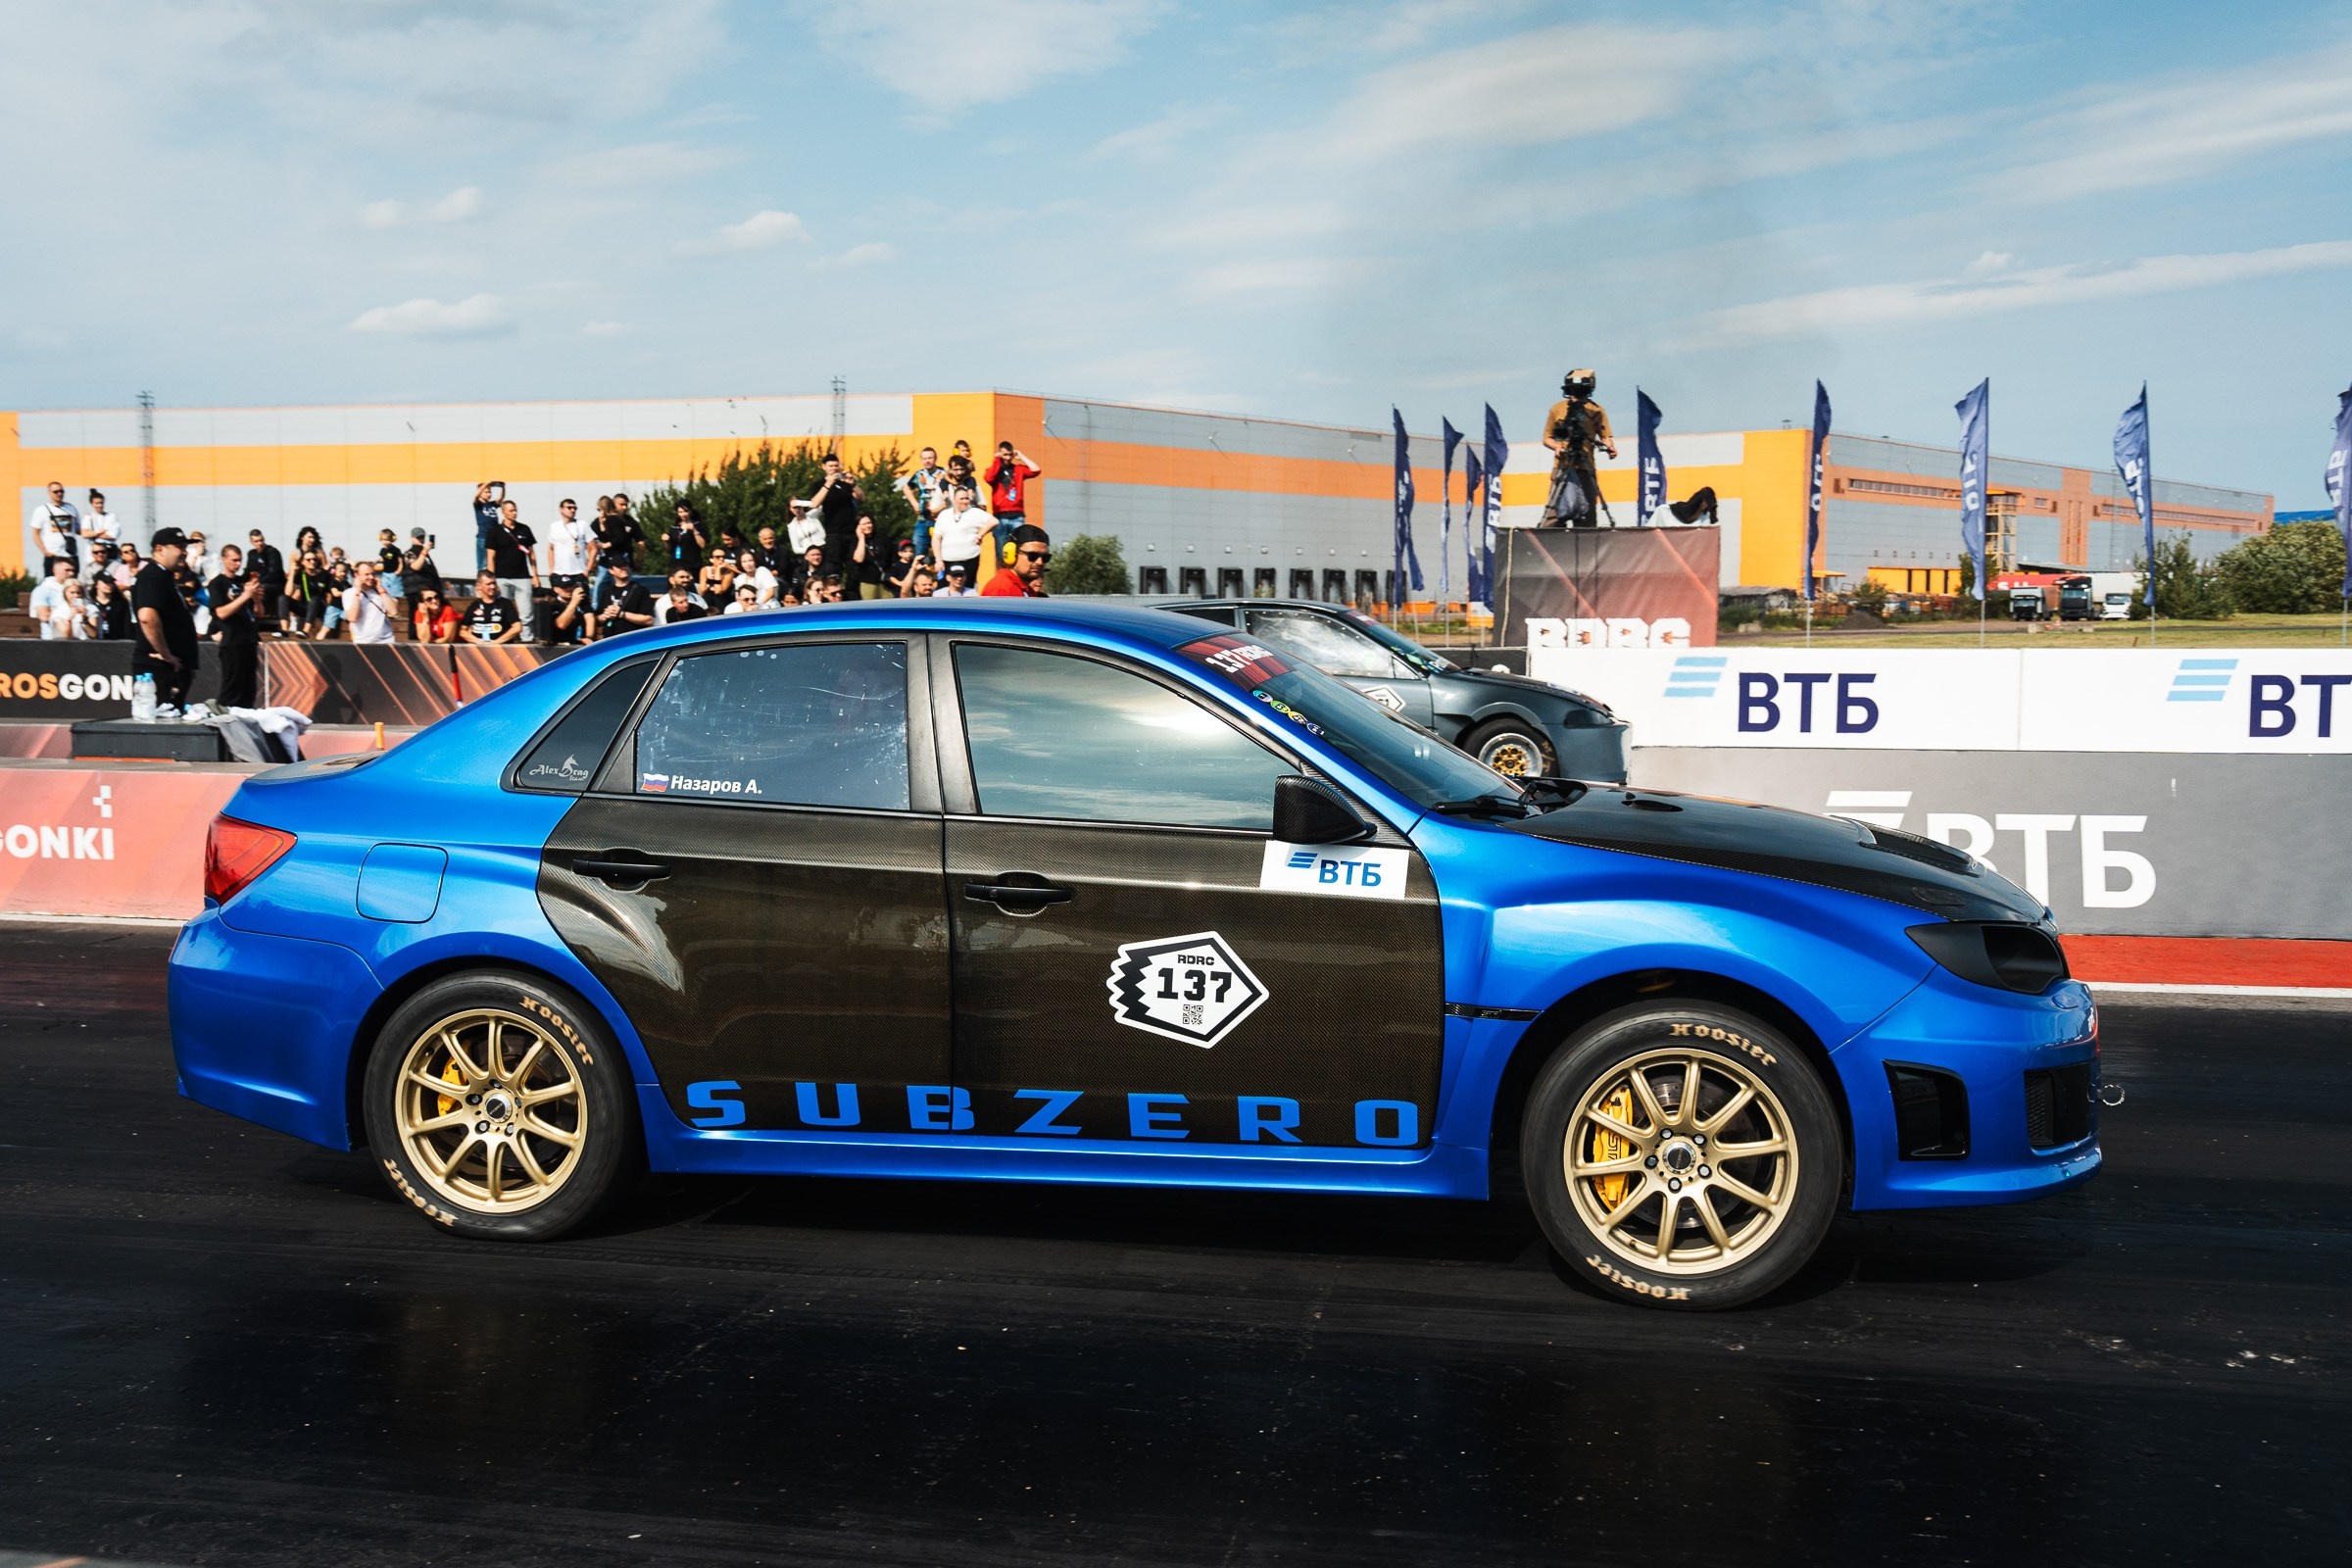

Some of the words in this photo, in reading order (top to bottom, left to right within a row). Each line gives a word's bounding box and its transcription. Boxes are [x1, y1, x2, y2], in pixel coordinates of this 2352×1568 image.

[1738, 672, 1880, 734] ВТБ
[670, 775, 741, 795] Назаров
[745, 779, 762, 794] А.
[0, 824, 115, 860] ONKI
[1318, 858, 1382, 887] ВТБ
[1177, 954, 1214, 966] RDRC
[1156, 967, 1232, 1004] 137
[1670, 1023, 1777, 1066] Hoosier
